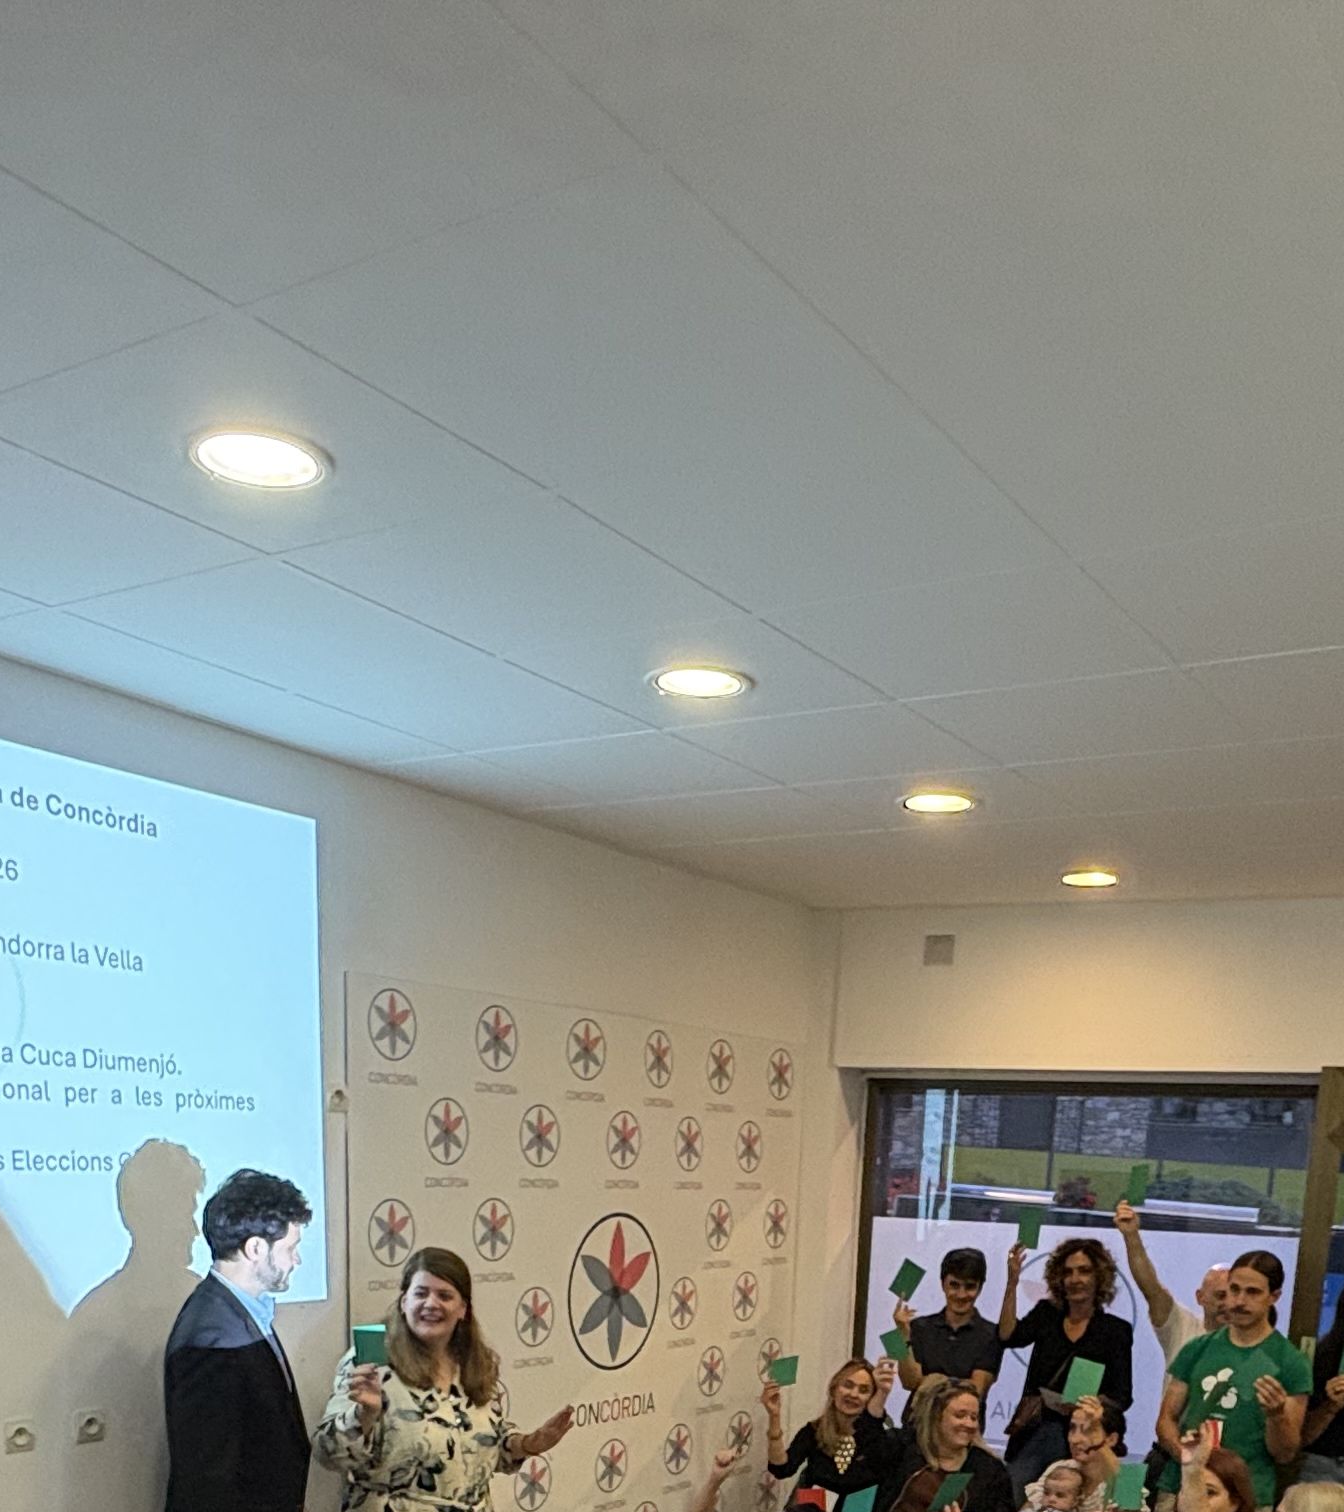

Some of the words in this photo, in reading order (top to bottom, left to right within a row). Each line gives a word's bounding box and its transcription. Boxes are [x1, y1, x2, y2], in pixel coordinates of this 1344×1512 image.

[10, 786, 39, 811] de
[45, 793, 158, 838] Concòrdia
[71, 942, 90, 964] la
[94, 945, 144, 972] Vella
[20, 1043, 77, 1068] Cuca
[83, 1048, 183, 1079] Diumenjó.
[64, 1086, 99, 1108] per
[111, 1088, 123, 1105] a
[135, 1086, 163, 1107] les
[175, 1088, 256, 1114] pròximes
[12, 1149, 114, 1173] Eleccions
[569, 1392, 656, 1428] ONCÒRDIA
